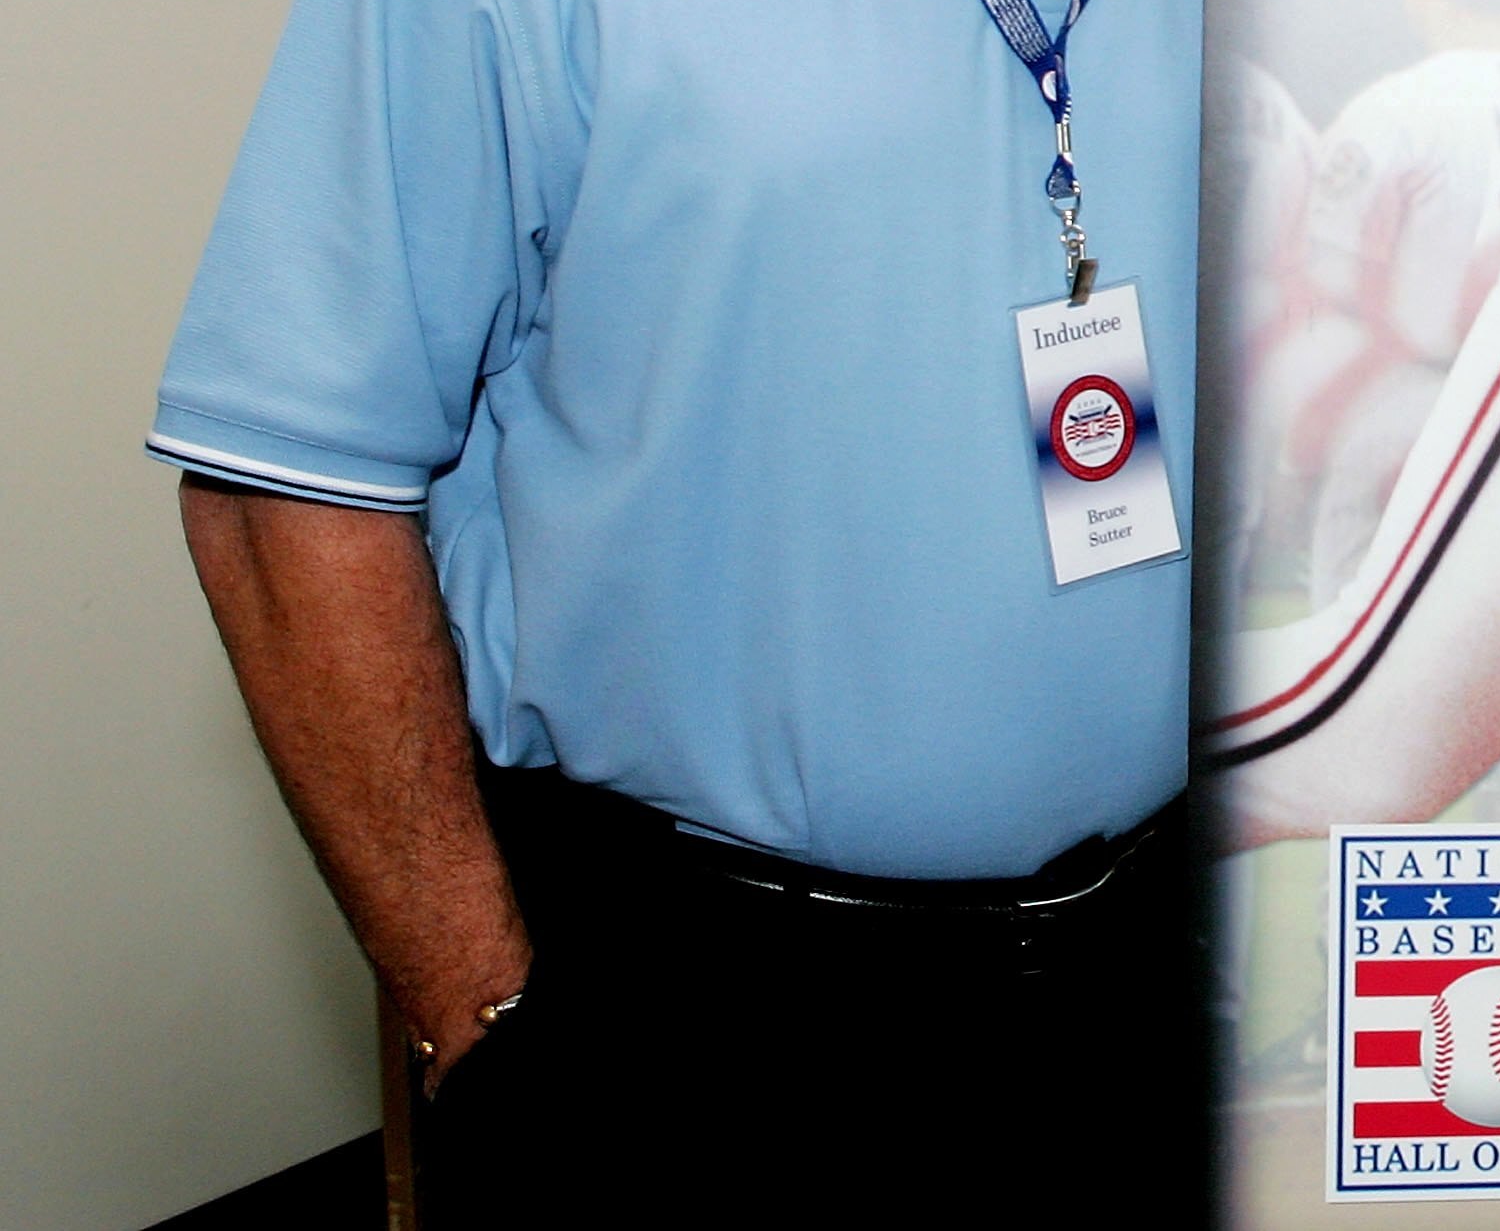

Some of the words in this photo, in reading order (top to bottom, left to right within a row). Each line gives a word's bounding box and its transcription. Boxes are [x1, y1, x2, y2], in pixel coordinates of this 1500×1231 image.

[1033, 316, 1122, 350] Inductee
[1087, 504, 1127, 525] Bruce
[1089, 524, 1133, 547] Sutter
[1352, 1143, 1460, 1173] HALL
